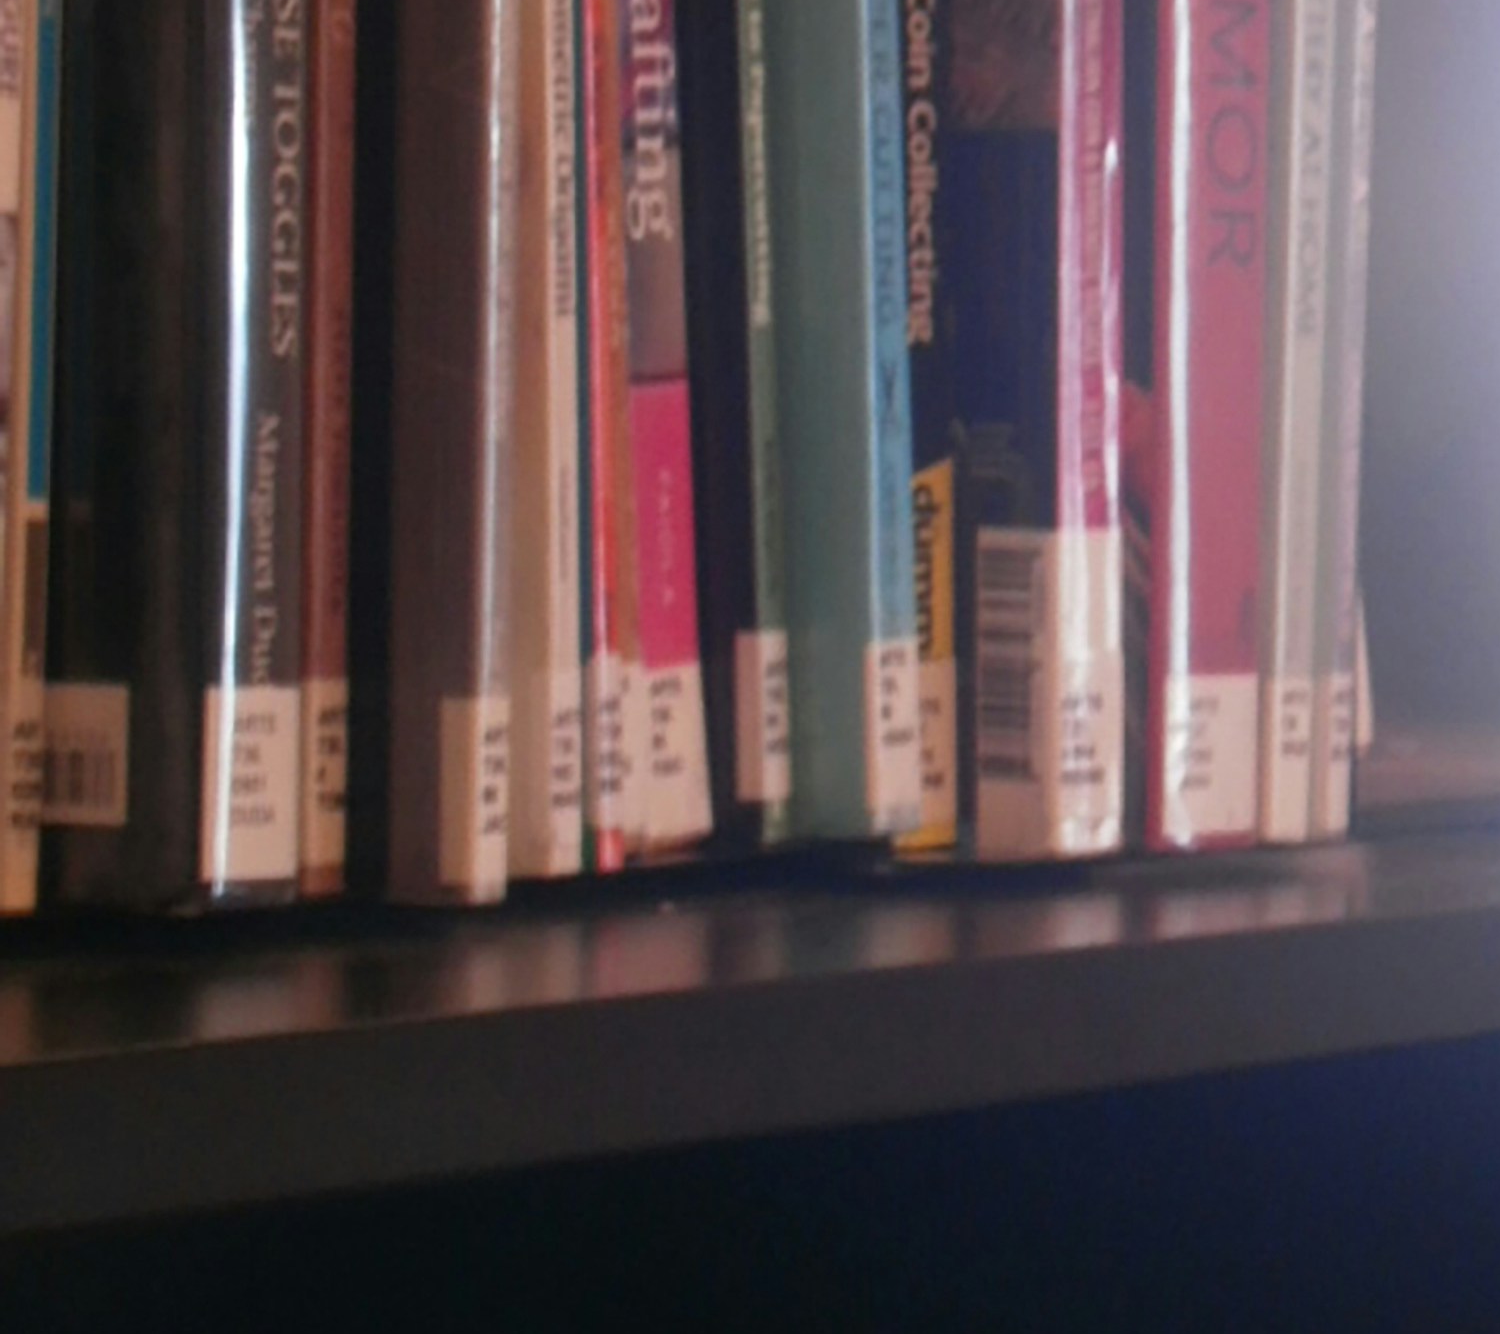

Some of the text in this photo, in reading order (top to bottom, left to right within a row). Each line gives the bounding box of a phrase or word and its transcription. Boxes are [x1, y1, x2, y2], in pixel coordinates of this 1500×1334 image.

[271, 80, 302, 358] TOGGLES
[905, 97, 940, 349] Collecting
[250, 410, 284, 591] Margaret
